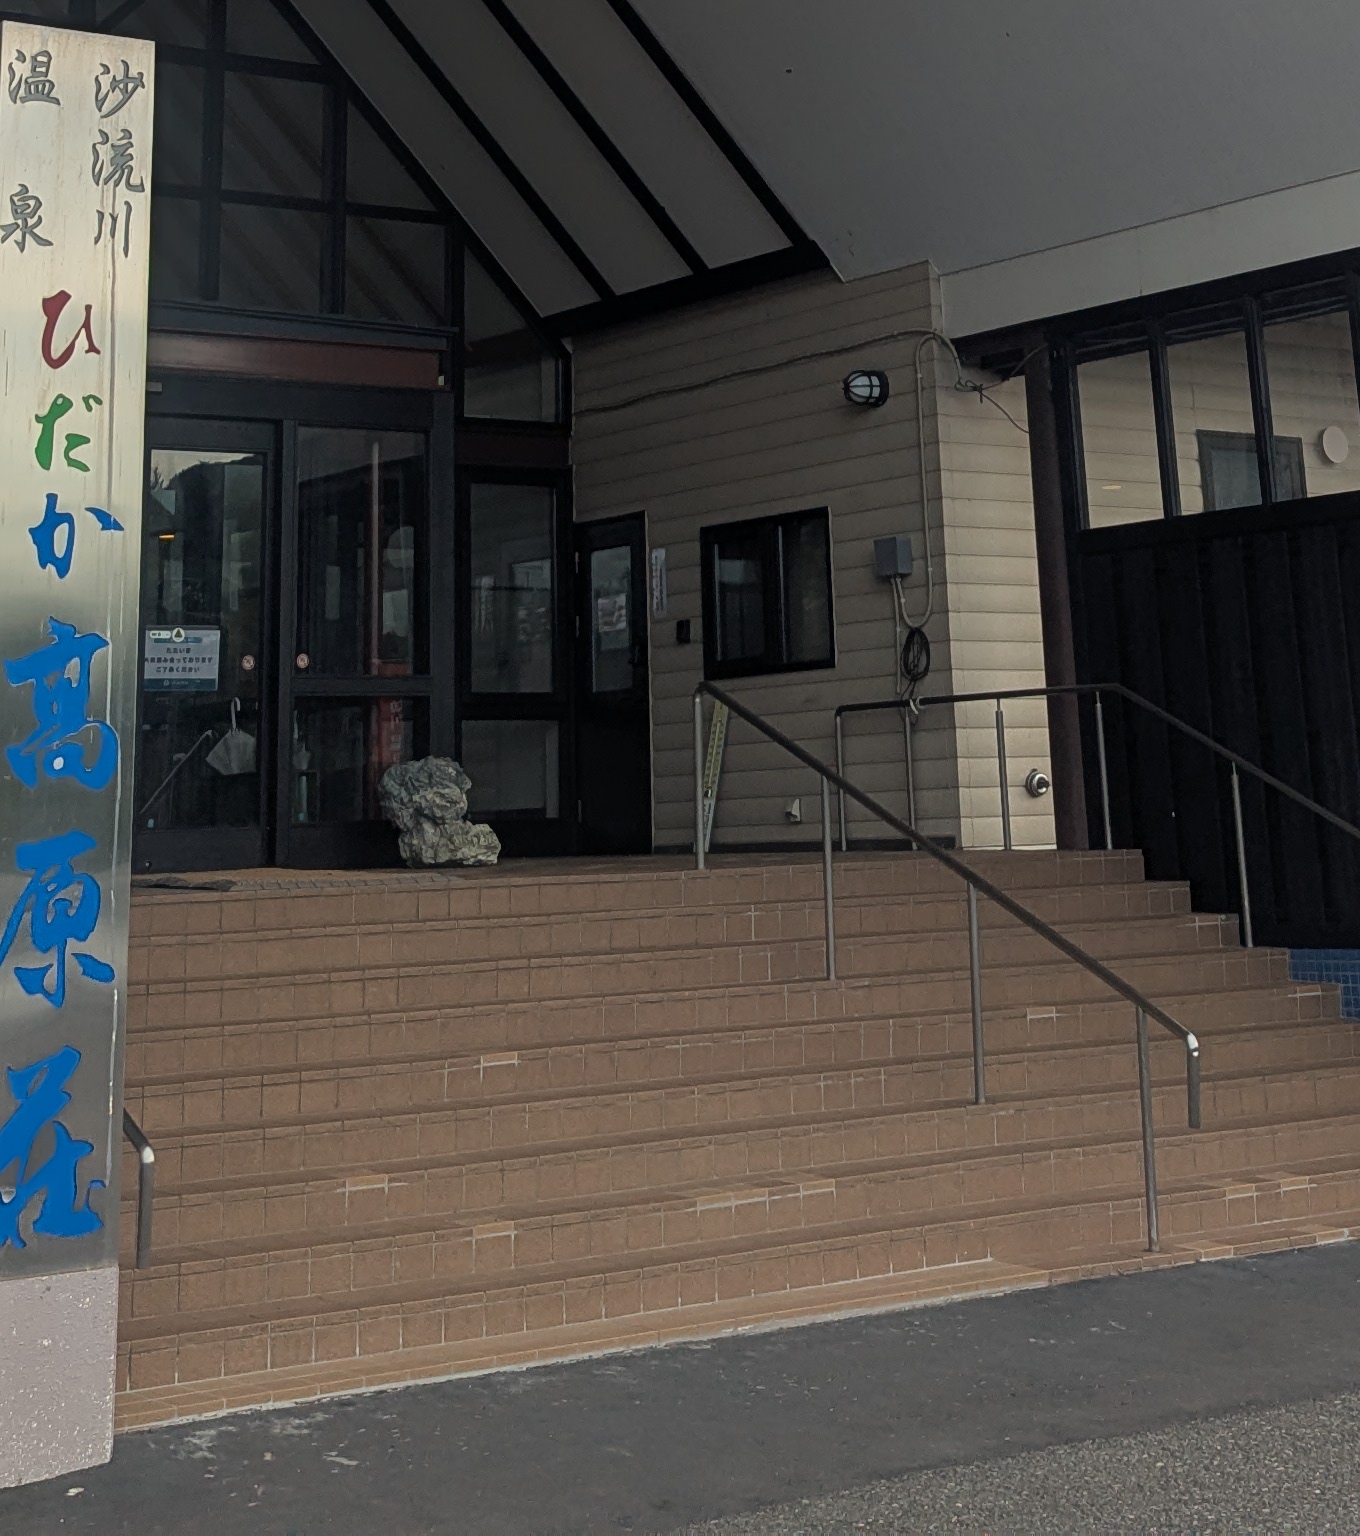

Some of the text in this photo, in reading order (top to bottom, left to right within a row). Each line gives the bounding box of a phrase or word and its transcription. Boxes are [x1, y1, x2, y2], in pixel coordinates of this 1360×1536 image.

[1, 48, 61, 253] 温泉
[90, 59, 146, 258] 沙流川
